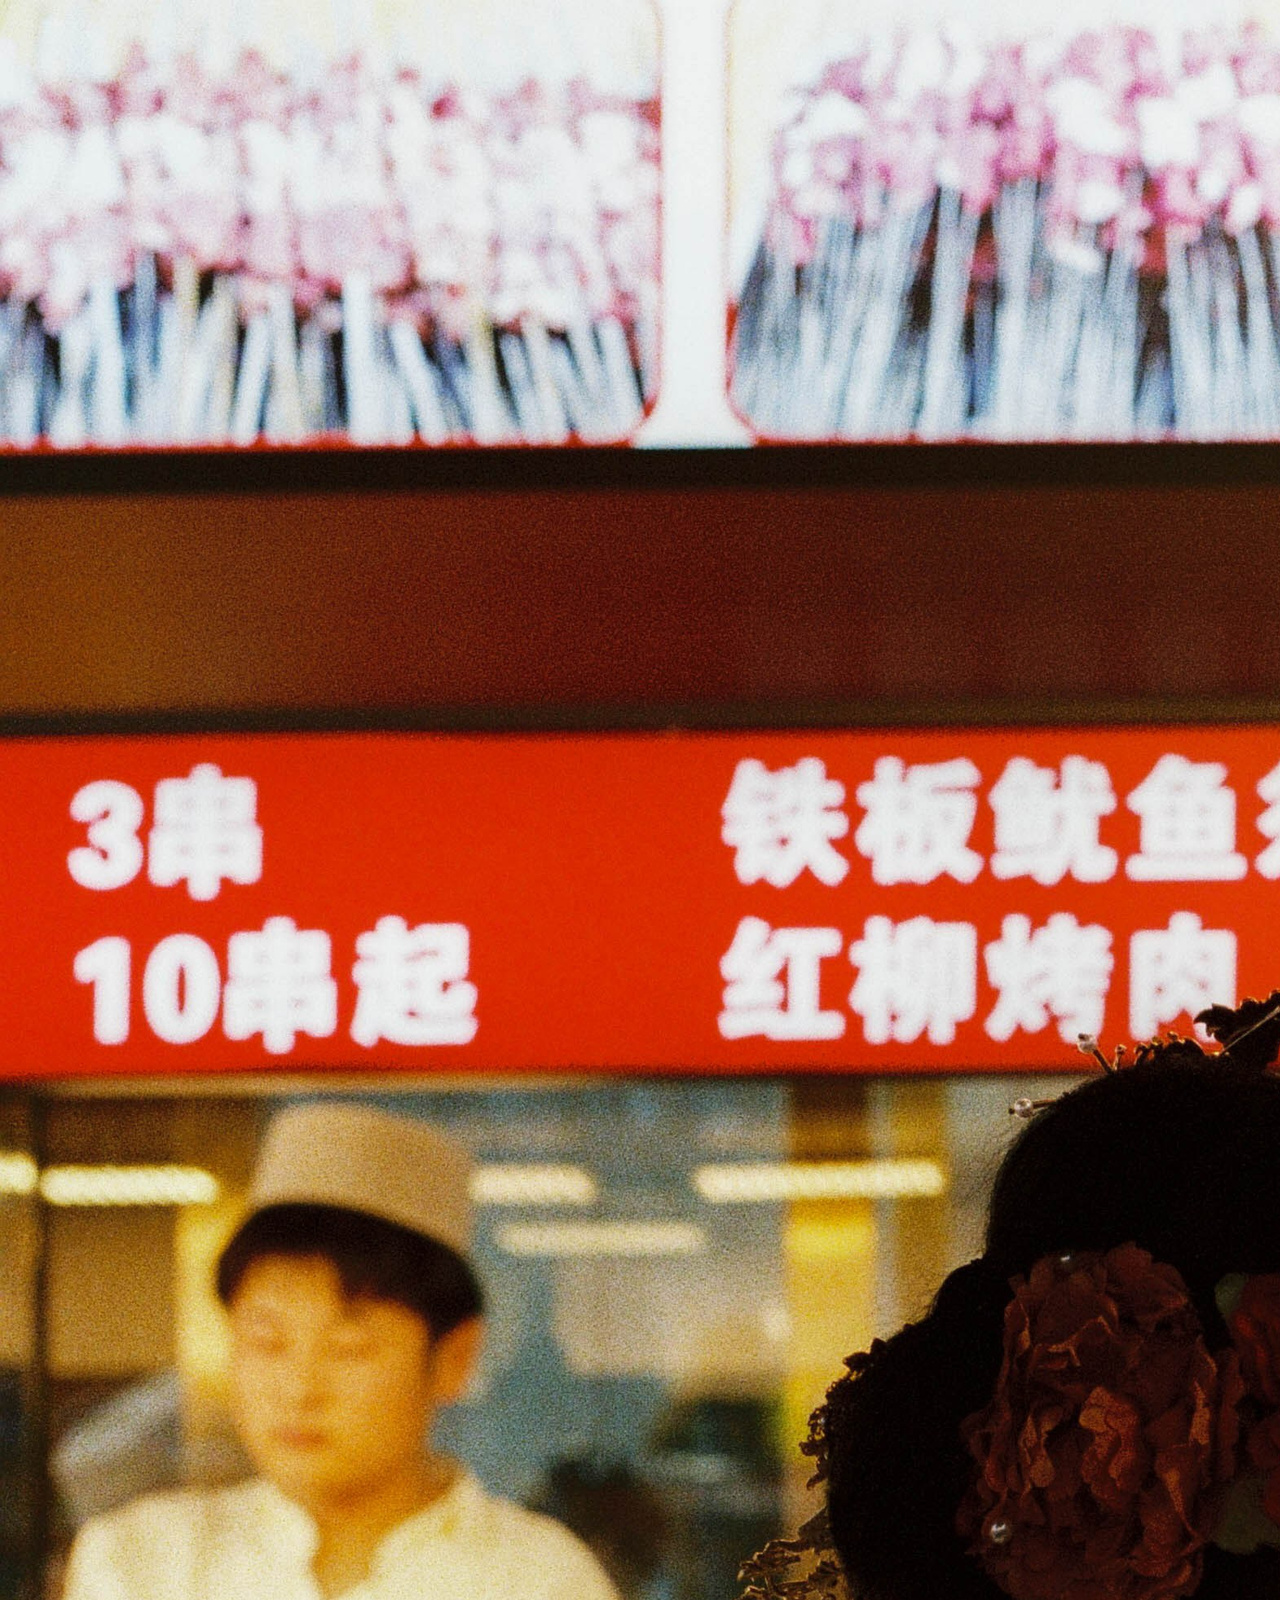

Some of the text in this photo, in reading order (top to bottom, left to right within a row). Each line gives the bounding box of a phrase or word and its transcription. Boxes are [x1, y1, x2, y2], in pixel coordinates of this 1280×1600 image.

[67, 763, 263, 901] 3串
[73, 915, 478, 1054] 10串起
[718, 911, 1237, 1047] 红柳烤肉
